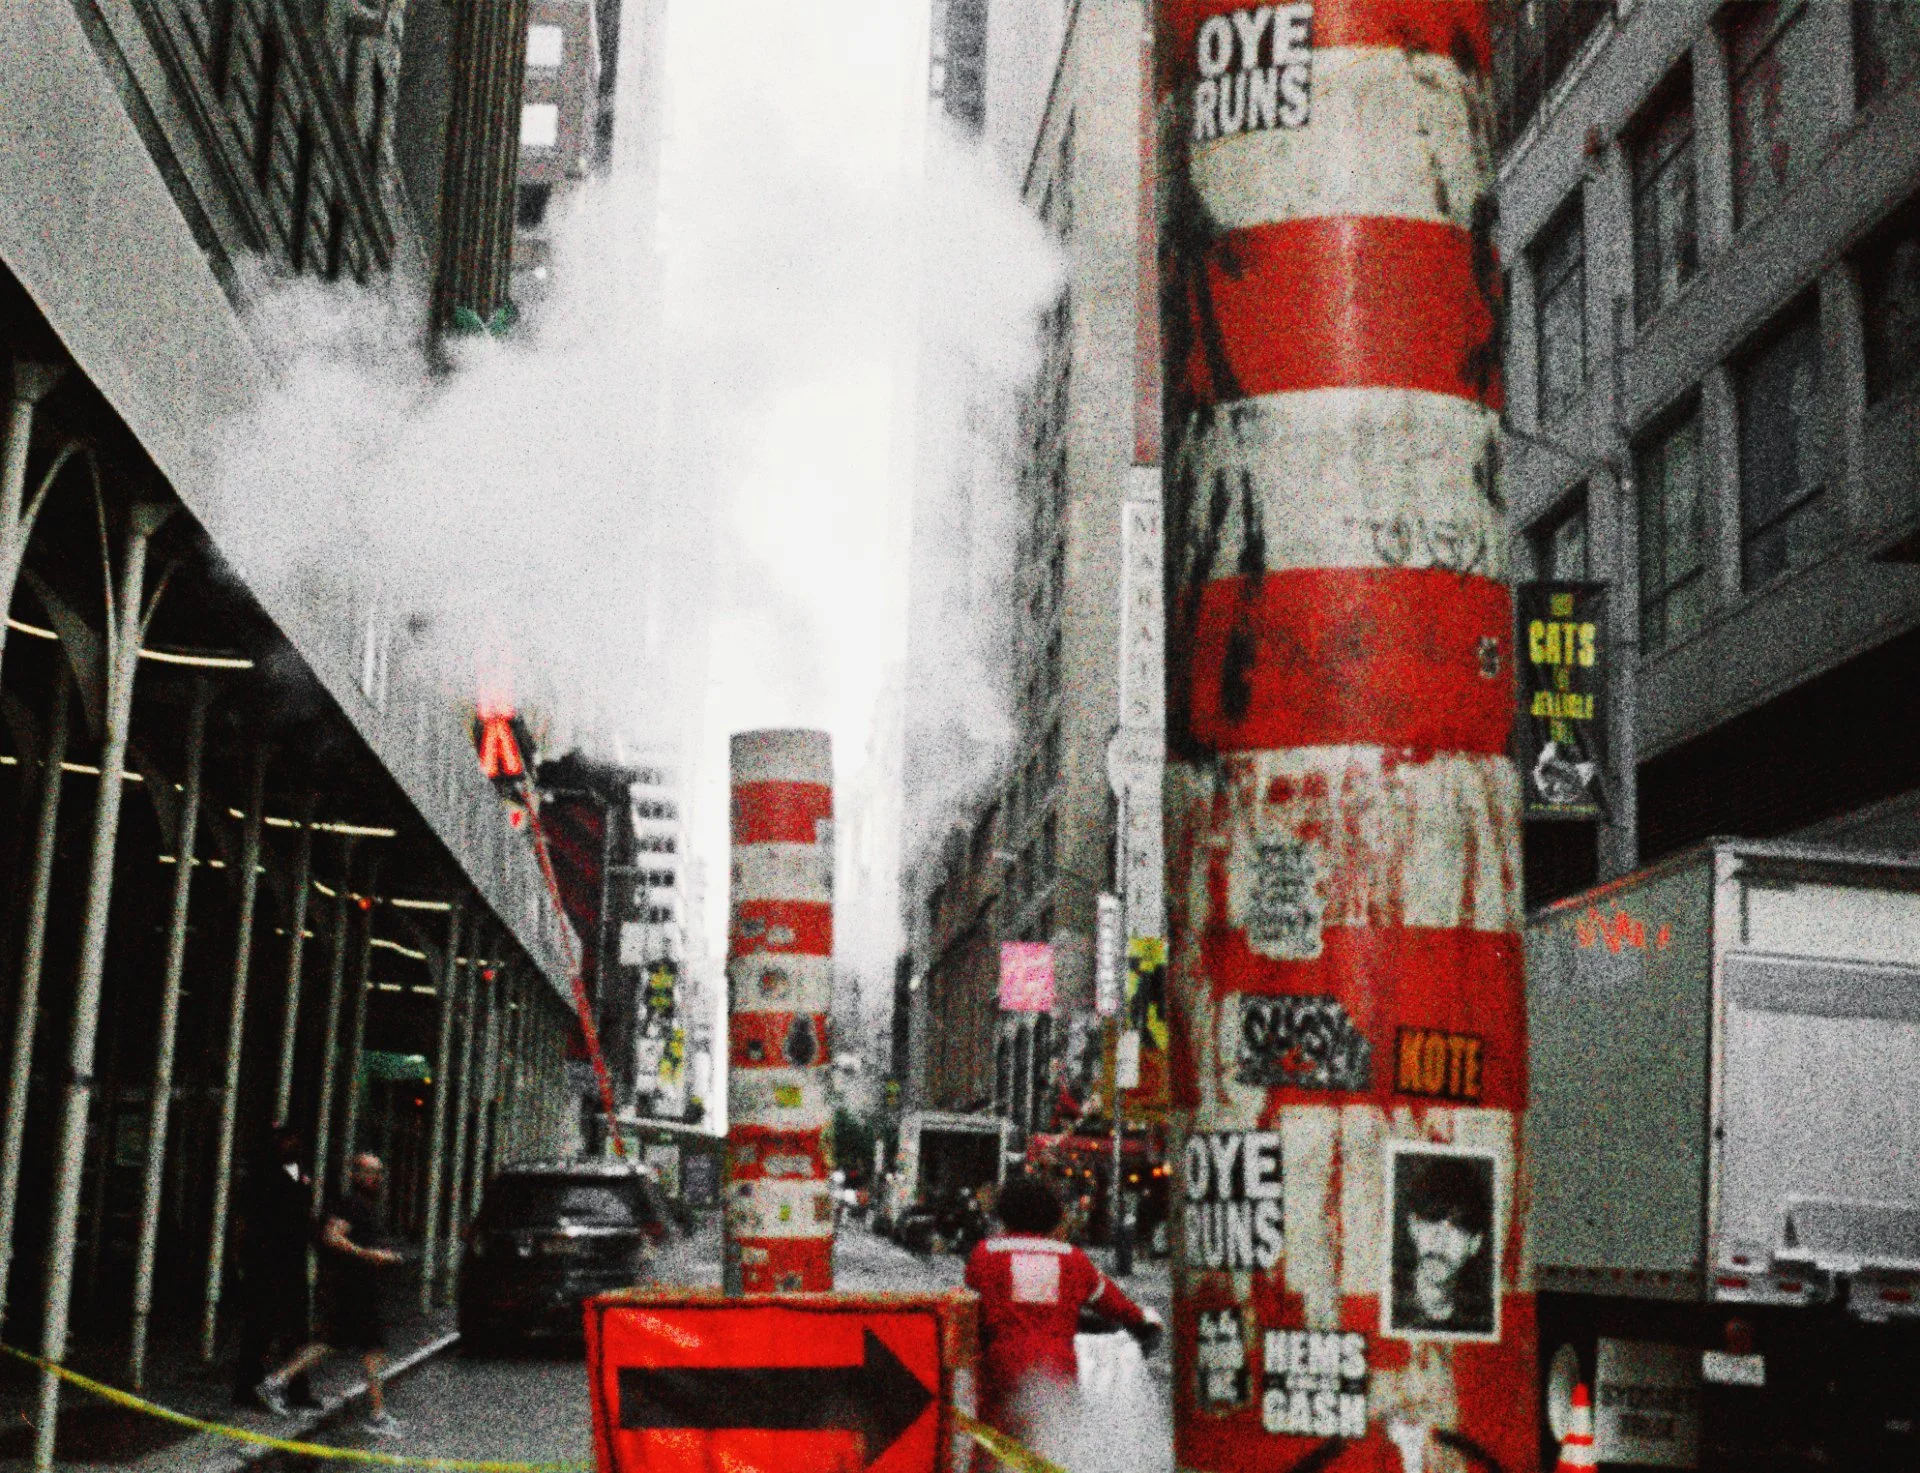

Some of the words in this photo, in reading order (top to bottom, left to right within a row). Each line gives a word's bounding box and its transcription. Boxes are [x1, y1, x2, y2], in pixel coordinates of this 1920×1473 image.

[1199, 4, 1313, 77] OYE
[1194, 65, 1311, 141] RUNS
[1530, 620, 1595, 667] CATS
[1185, 1133, 1283, 1199] OYE
